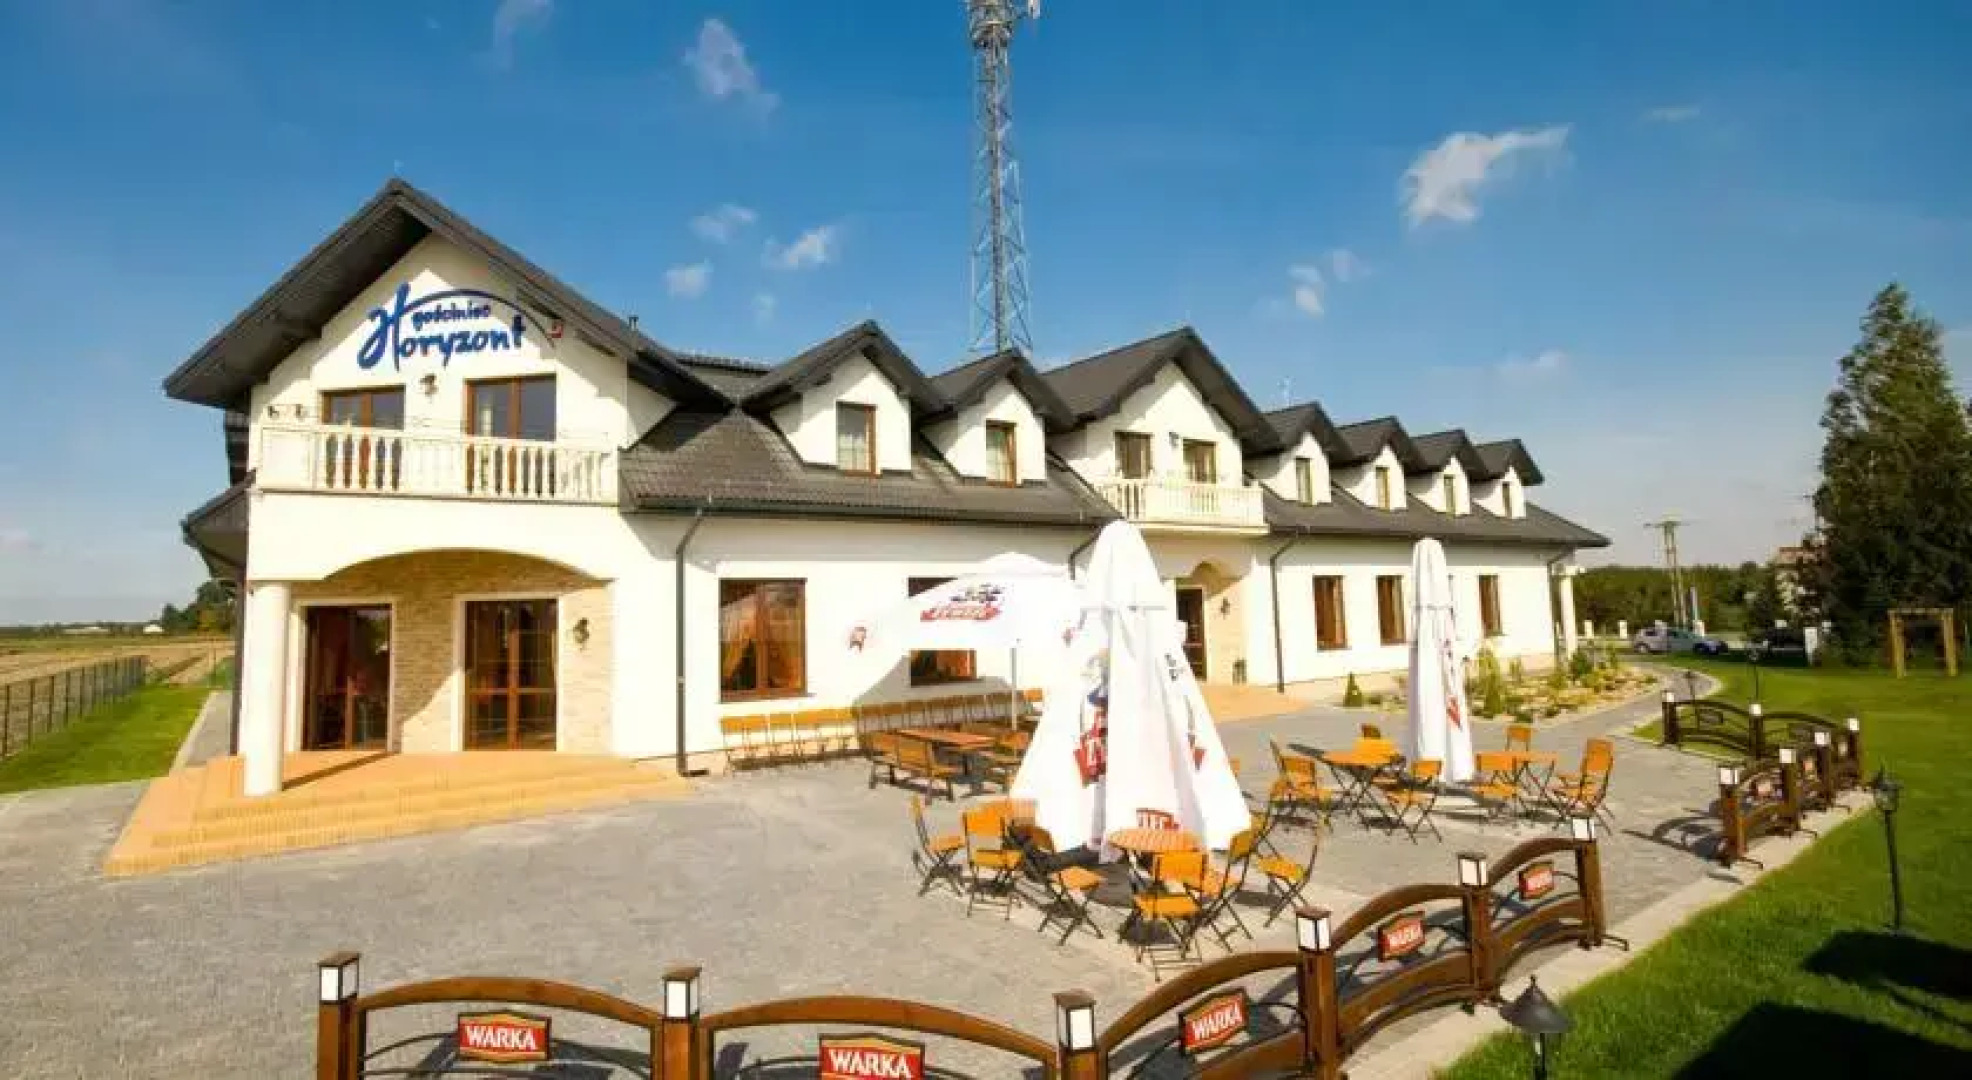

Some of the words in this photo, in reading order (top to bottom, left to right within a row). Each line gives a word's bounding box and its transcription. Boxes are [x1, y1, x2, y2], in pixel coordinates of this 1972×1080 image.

[357, 282, 526, 371] Horyzont
[465, 1025, 538, 1051] WARKA
[1192, 1002, 1242, 1041] WARKA
[828, 1048, 913, 1079] WARKA
